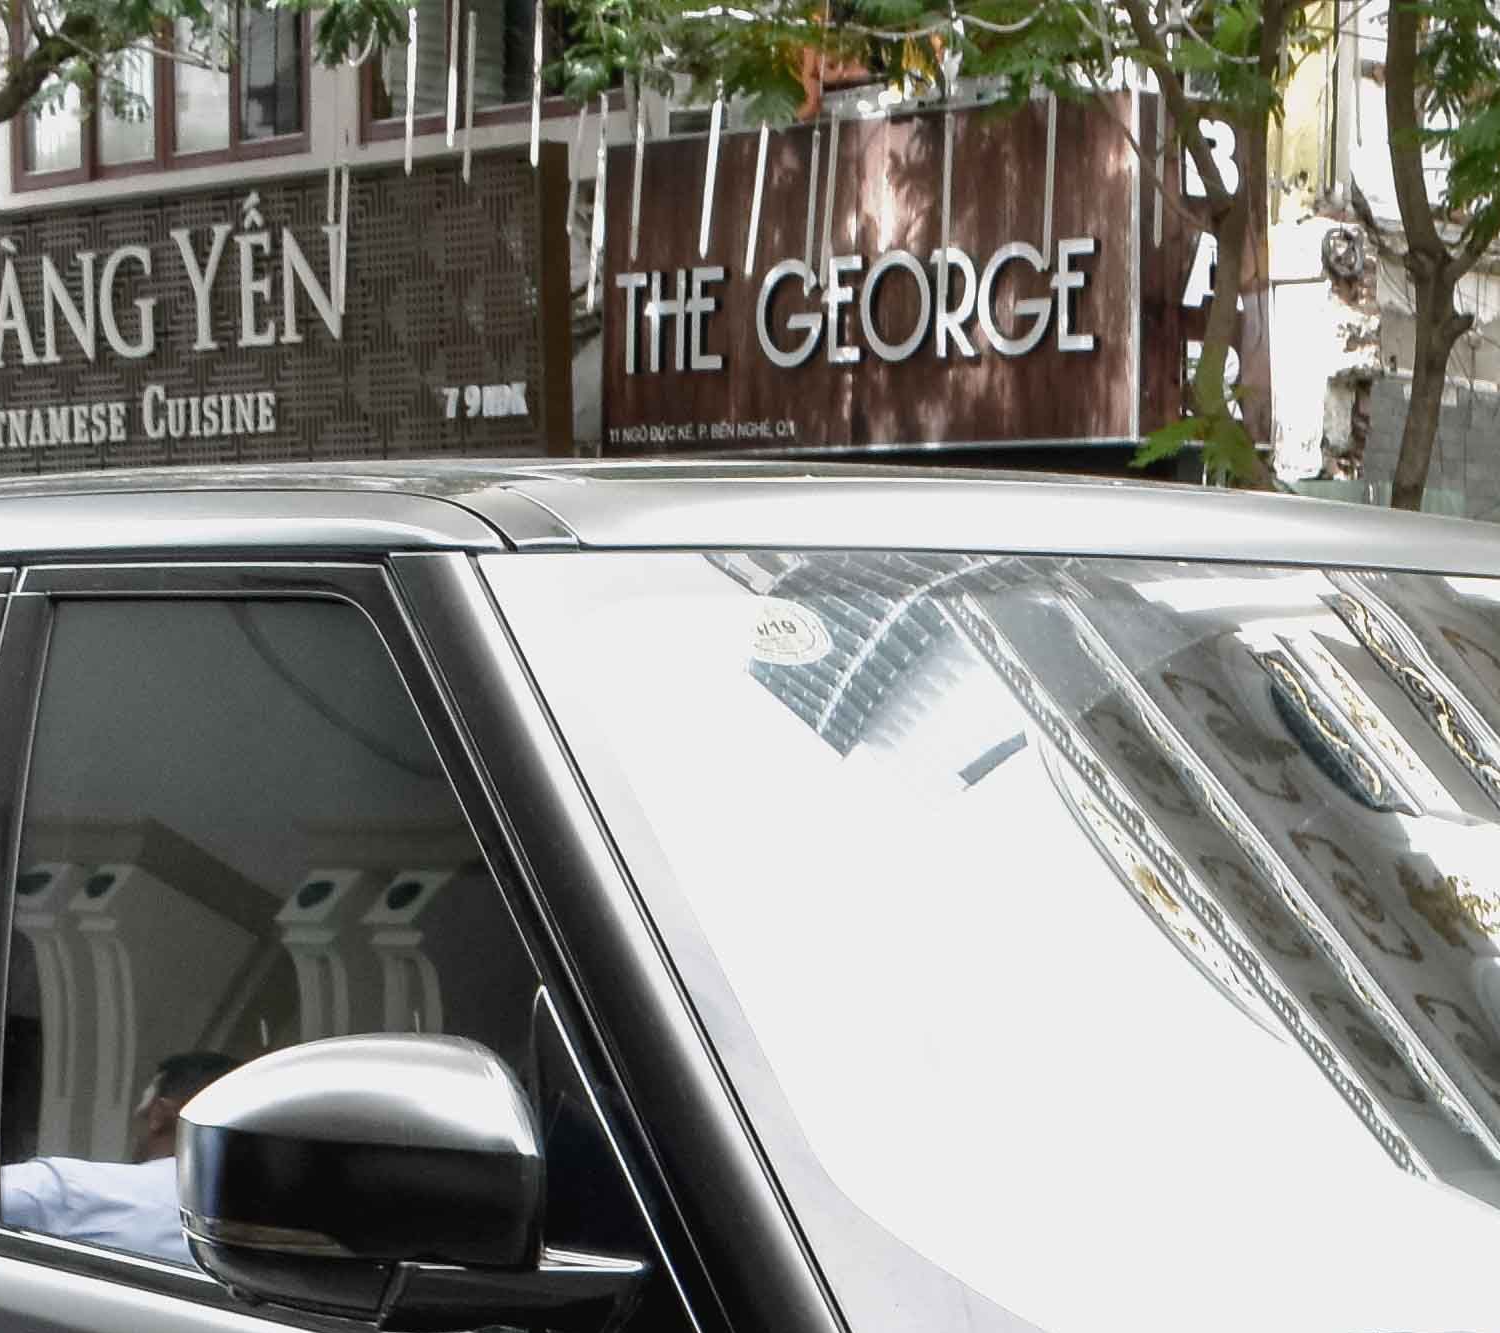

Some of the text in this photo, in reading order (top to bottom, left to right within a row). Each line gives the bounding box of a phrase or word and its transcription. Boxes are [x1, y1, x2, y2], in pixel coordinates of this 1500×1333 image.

[170, 190, 343, 352] YÊN
[616, 238, 1095, 375] THE GEORGE
[143, 384, 276, 439] CUISINE
